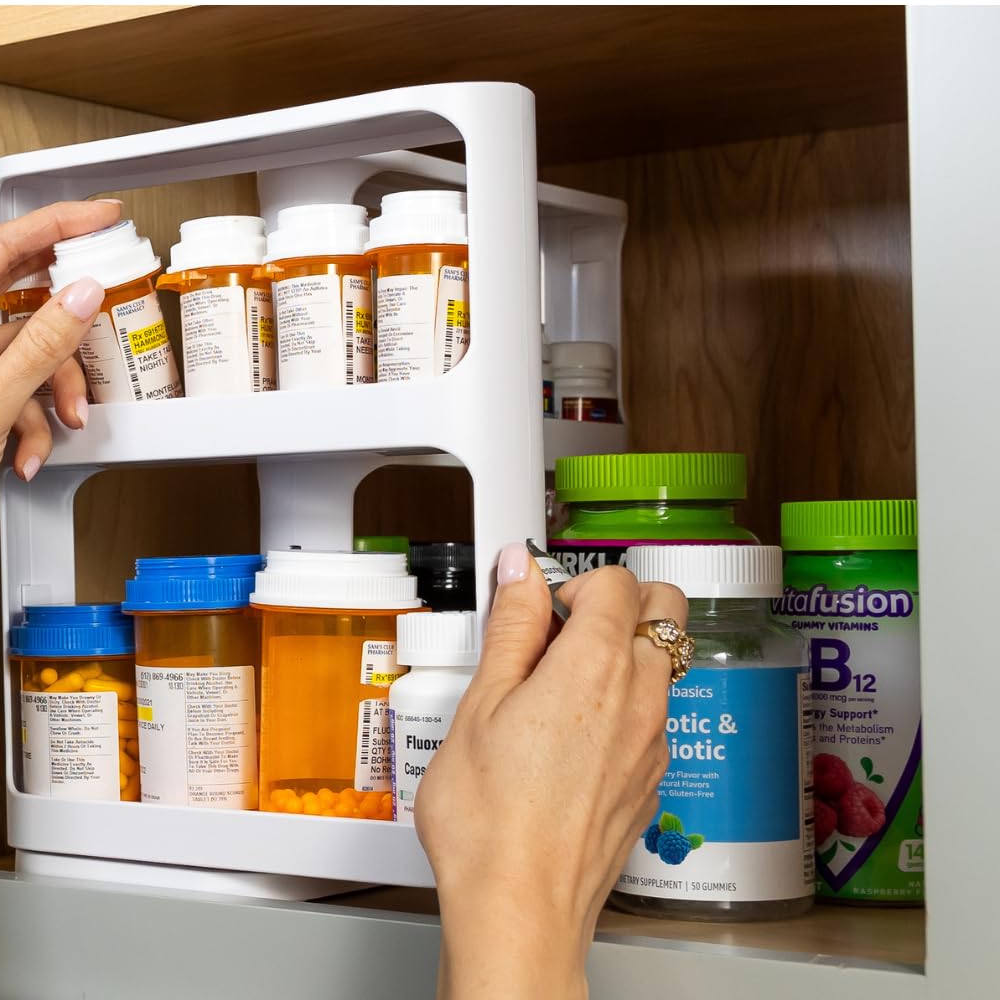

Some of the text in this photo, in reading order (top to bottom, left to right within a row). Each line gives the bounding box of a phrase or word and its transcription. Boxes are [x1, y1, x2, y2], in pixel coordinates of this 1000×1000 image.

[132, 333, 142, 342] Rx
[138, 353, 158, 364] TAKE
[140, 356, 169, 373] NIGHTLY
[792, 620, 879, 632] GUMMY VITAMINS
[671, 685, 713, 698] basics
[830, 693, 847, 703] mcg
[718, 713, 738, 734] &
[819, 723, 894, 735] the Metabolism
[819, 735, 836, 744] and
[372, 747, 384, 757] QTY
[371, 766, 381, 774] No
[676, 771, 719, 780] Flavor with
[682, 780, 710, 789] Flavors
[668, 789, 715, 798] Gluten-Free
[640, 877, 682, 890] SUPPLEMENT
[691, 881, 700, 890] 50
[702, 881, 737, 892] GUMMIES
